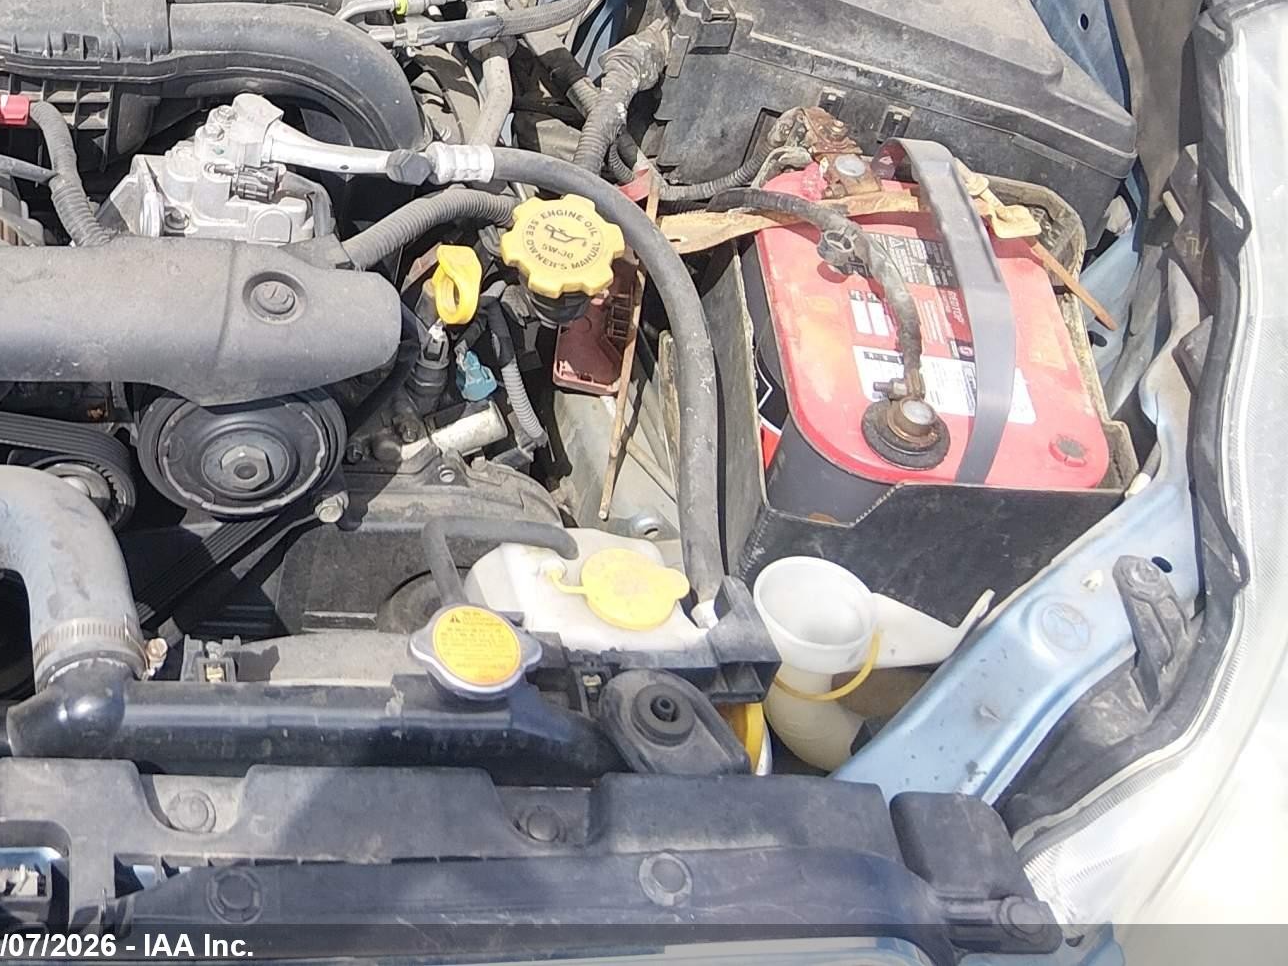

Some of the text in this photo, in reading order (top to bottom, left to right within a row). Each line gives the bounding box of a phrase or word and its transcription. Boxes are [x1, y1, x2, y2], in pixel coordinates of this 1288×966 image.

[540, 209, 598, 237] ENGINE OIL
[526, 219, 601, 270] SEE OWNER'S MANUAL
[541, 243, 574, 259] 5W-30
